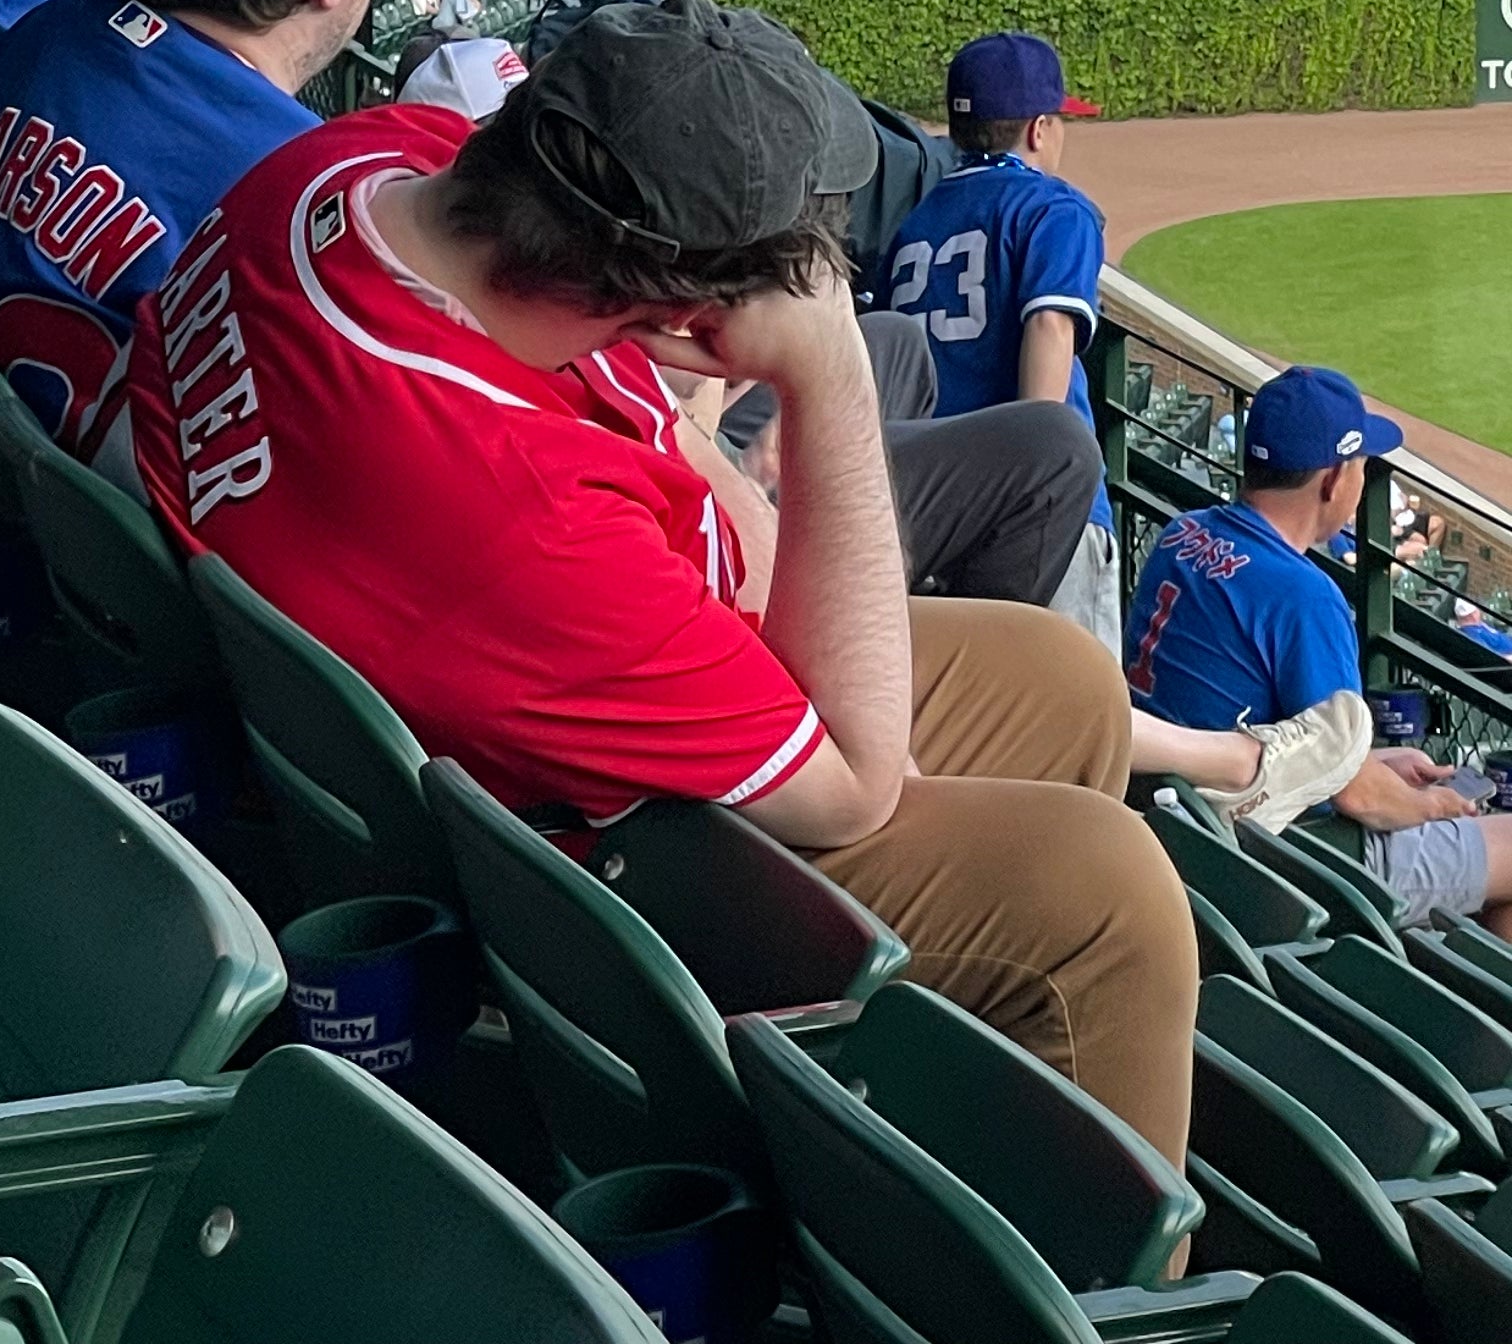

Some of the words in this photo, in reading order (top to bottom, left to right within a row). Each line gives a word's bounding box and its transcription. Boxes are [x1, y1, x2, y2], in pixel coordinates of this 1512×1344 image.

[891, 229, 988, 341] 23
[1128, 580, 1181, 697] 1
[1229, 791, 1270, 820] HOKA
[314, 1022, 372, 1042] Hefty
